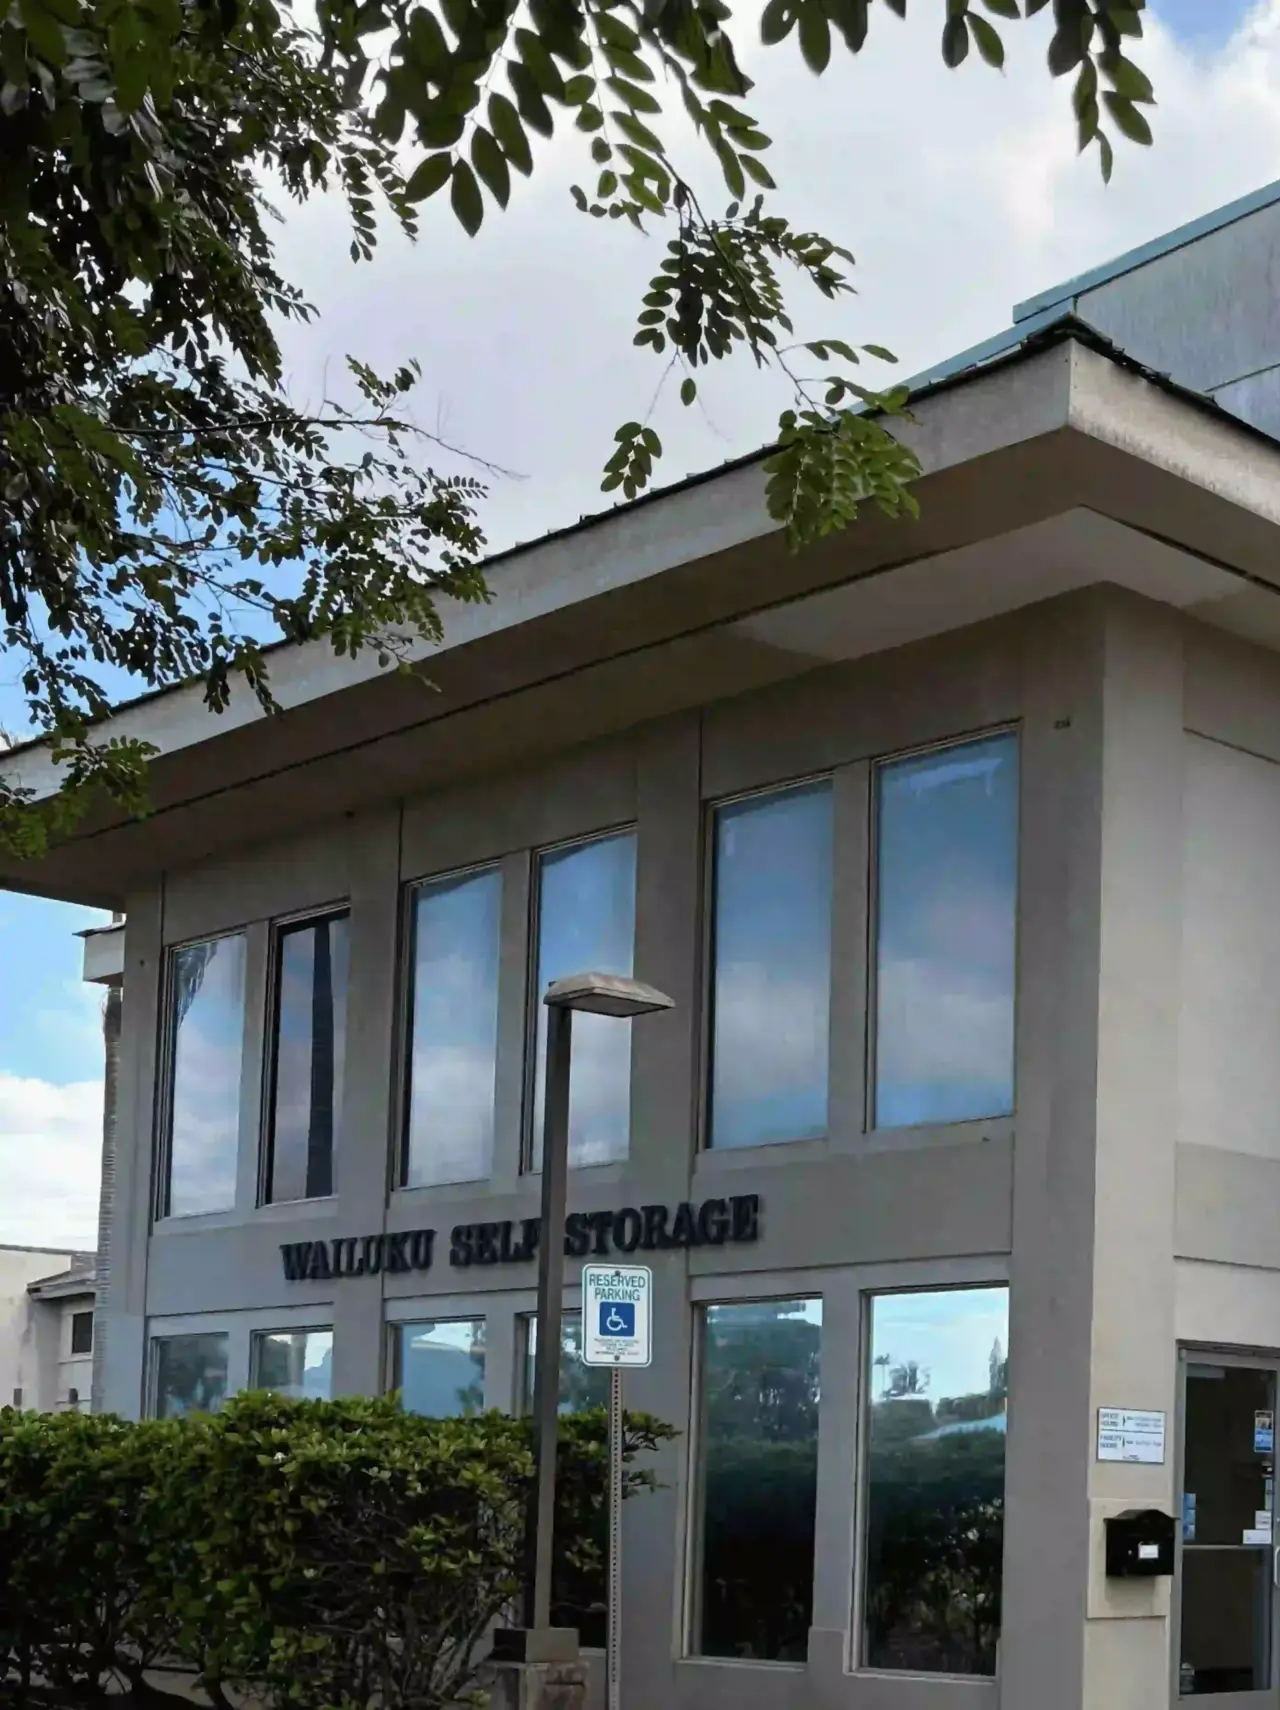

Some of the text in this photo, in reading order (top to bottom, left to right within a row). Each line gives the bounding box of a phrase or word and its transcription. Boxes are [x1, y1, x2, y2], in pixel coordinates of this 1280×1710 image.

[279, 1229, 438, 1281] WAILUKU
[564, 1194, 759, 1256] STORAGE
[589, 1273, 646, 1289] RESERVED
[595, 1288, 641, 1302] PARKING
